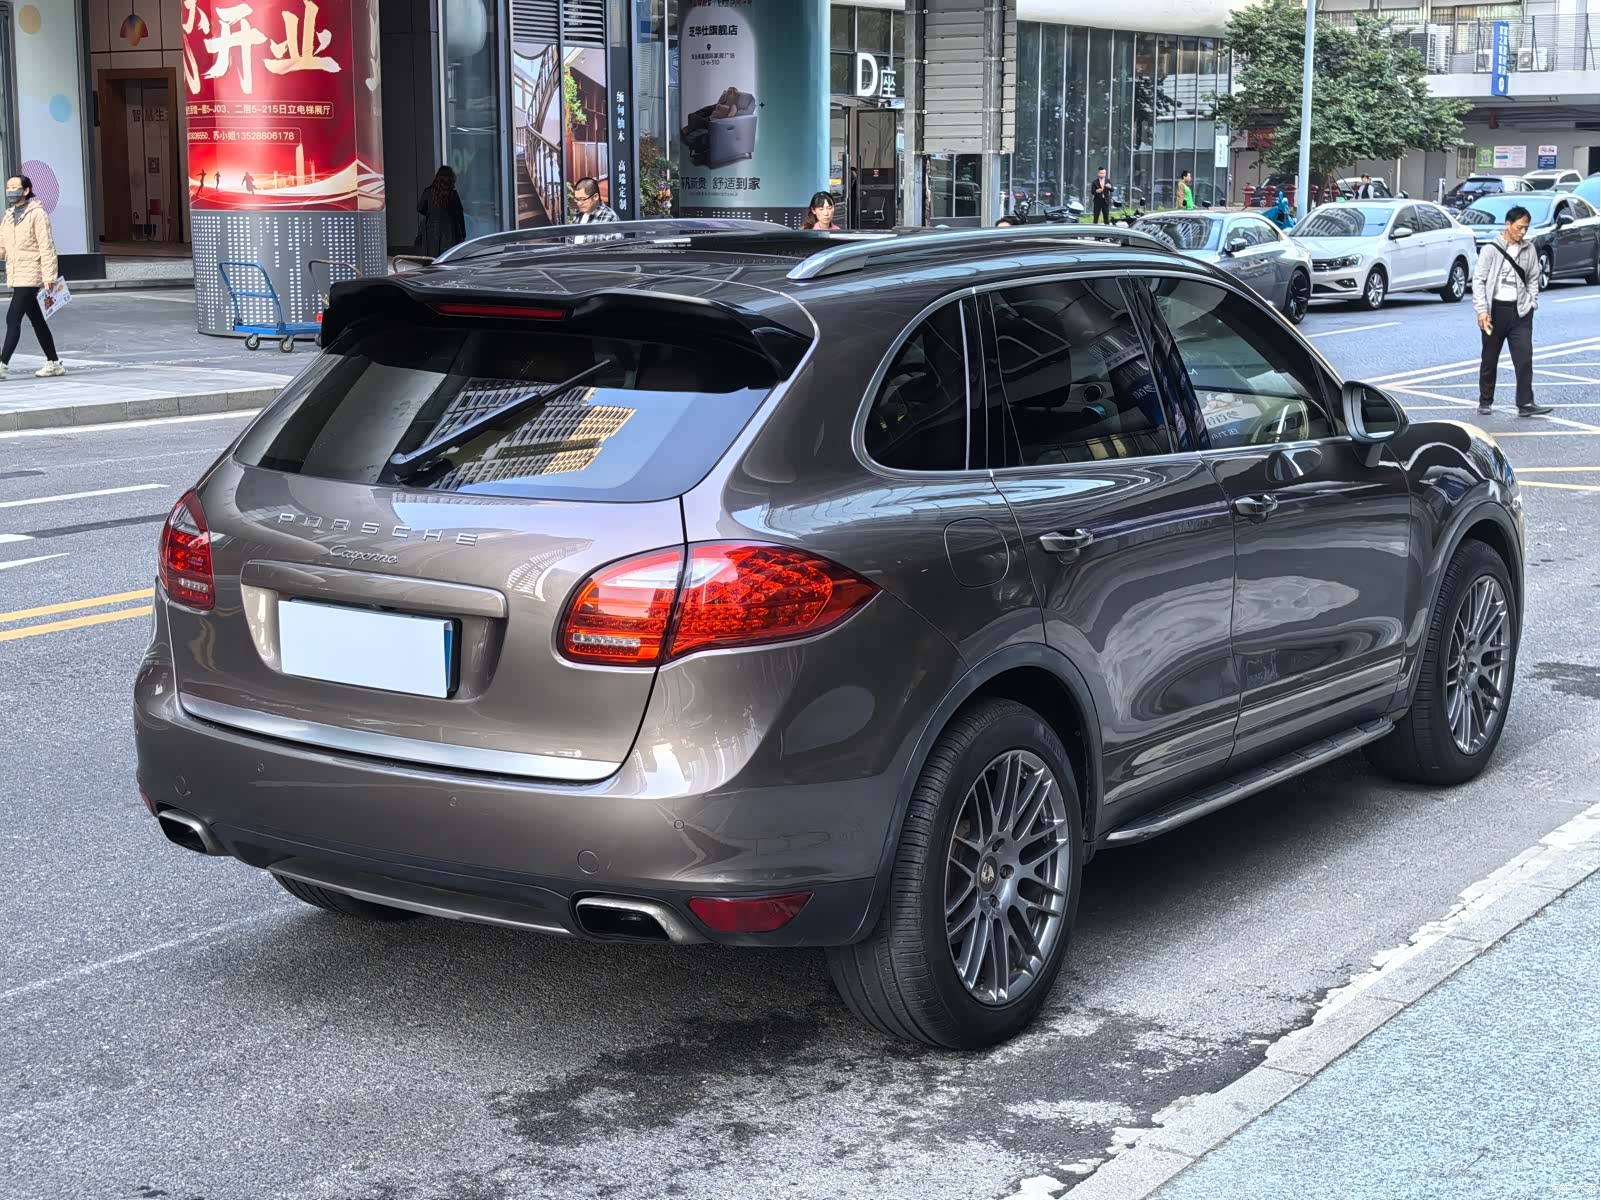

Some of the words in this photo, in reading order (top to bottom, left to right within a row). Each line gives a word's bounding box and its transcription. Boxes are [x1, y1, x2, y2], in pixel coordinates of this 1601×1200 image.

[857, 53, 896, 97] D座
[712, 177, 761, 190] 舒适到家
[278, 513, 479, 546] PORSCHE
[329, 545, 399, 565] Cayenne
